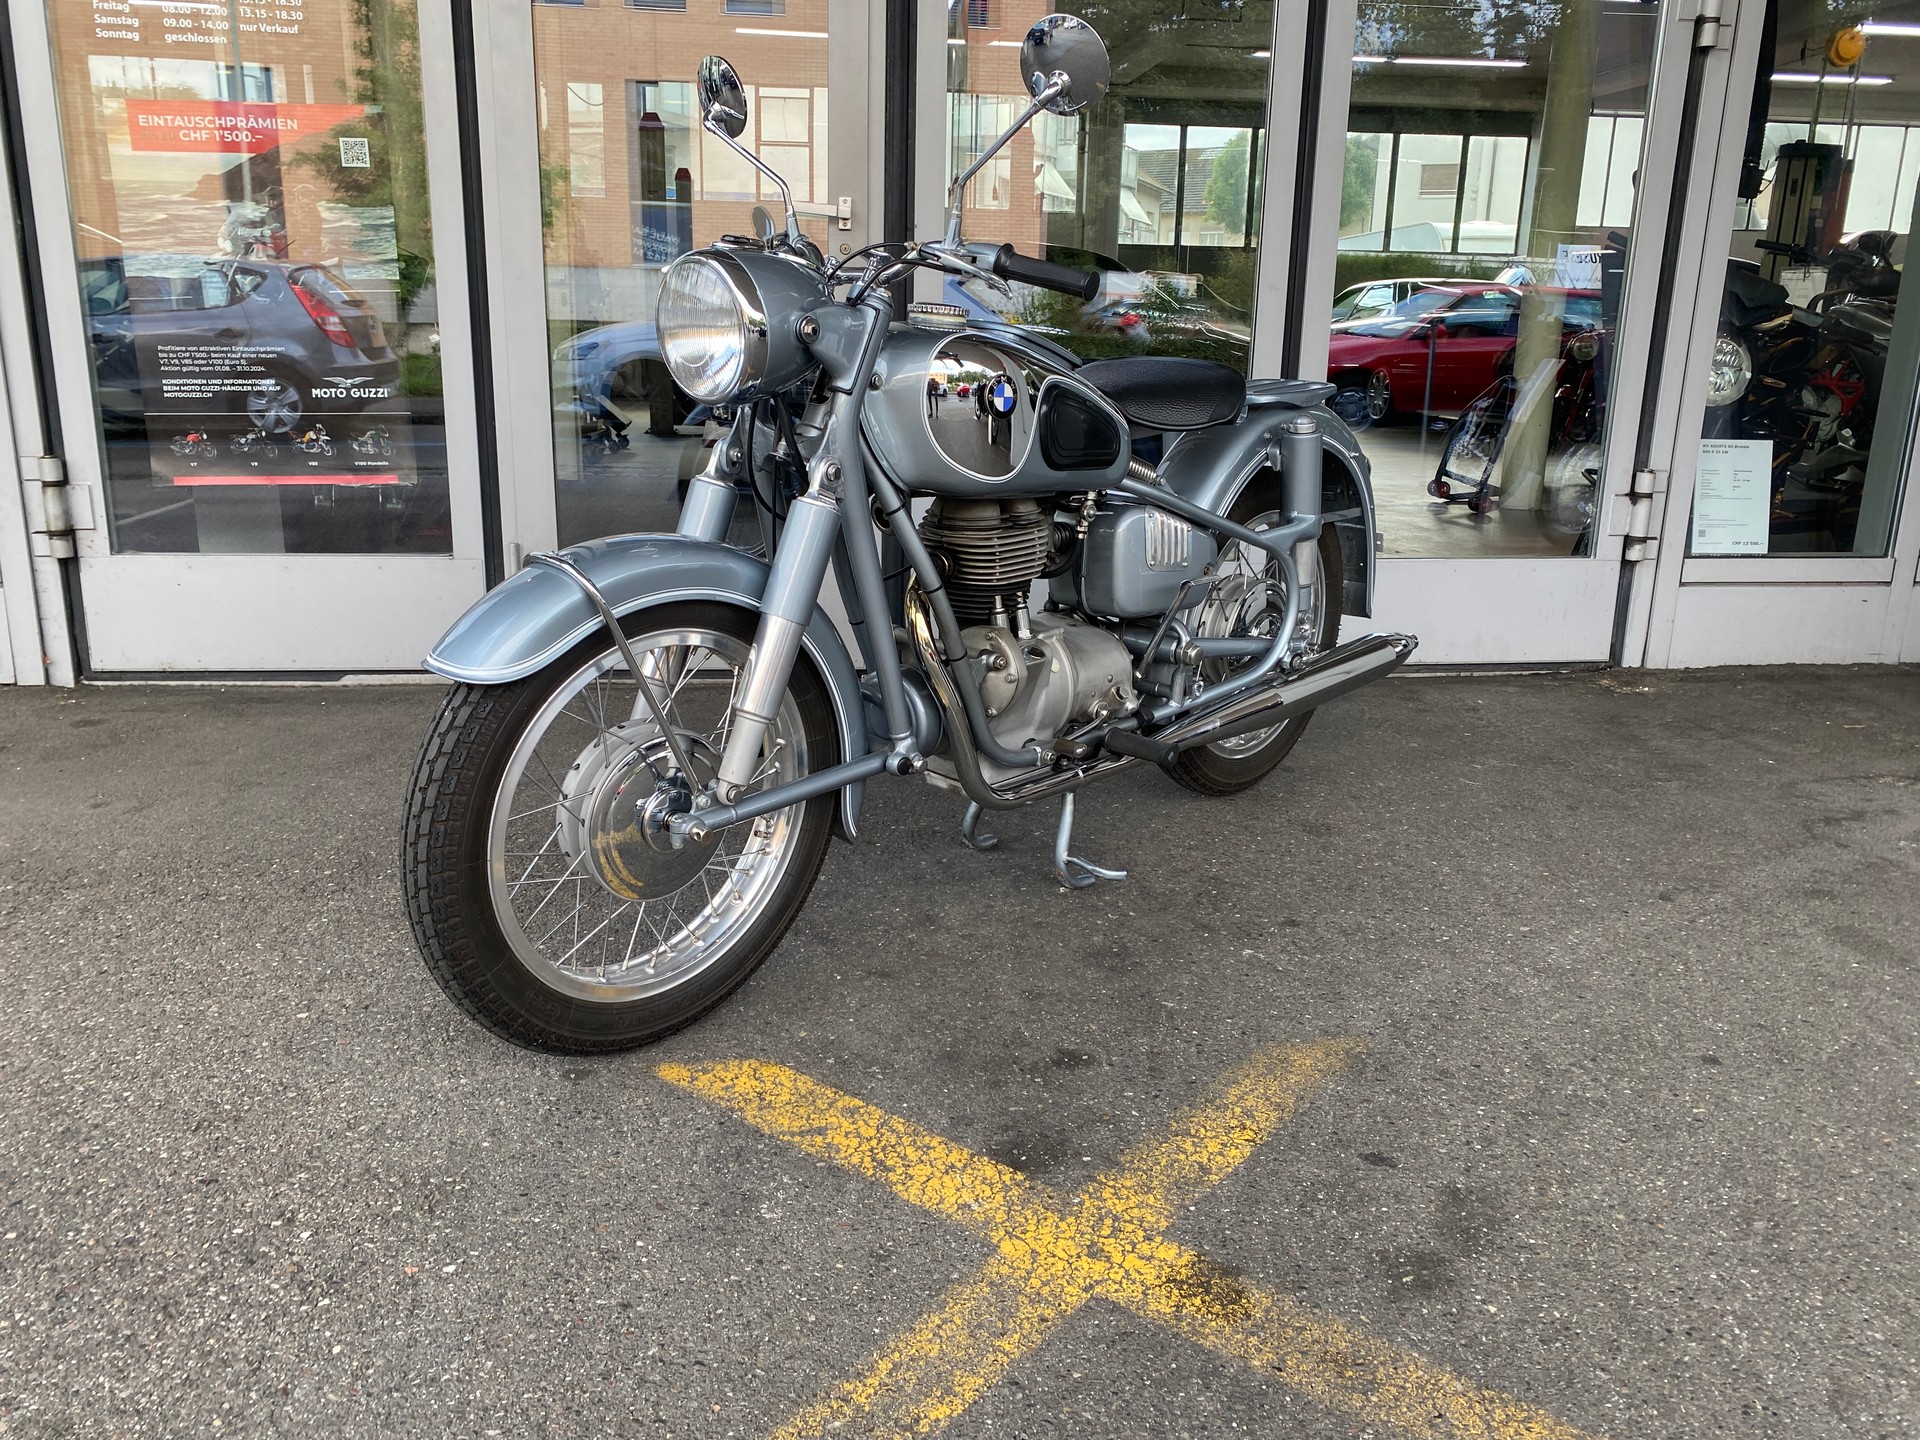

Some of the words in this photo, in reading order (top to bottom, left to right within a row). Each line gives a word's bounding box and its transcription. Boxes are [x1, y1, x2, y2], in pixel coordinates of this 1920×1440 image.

[92, 0, 130, 13] Freitag
[239, 8, 267, 18] 13.15
[274, 10, 303, 20] 18.30
[94, 14, 140, 28] Samstag
[163, 18, 192, 28] 09.00
[201, 20, 228, 30] 14.00
[95, 28, 140, 41] Sonntag
[258, 23, 299, 34] Verkauf
[164, 32, 227, 44] geschlossen
[138, 114, 298, 130] EINTAUSCHPRÄMIEN
[179, 130, 210, 141] CHF
[311, 388, 346, 398] MOTO
[350, 388, 388, 398] GUZZI
